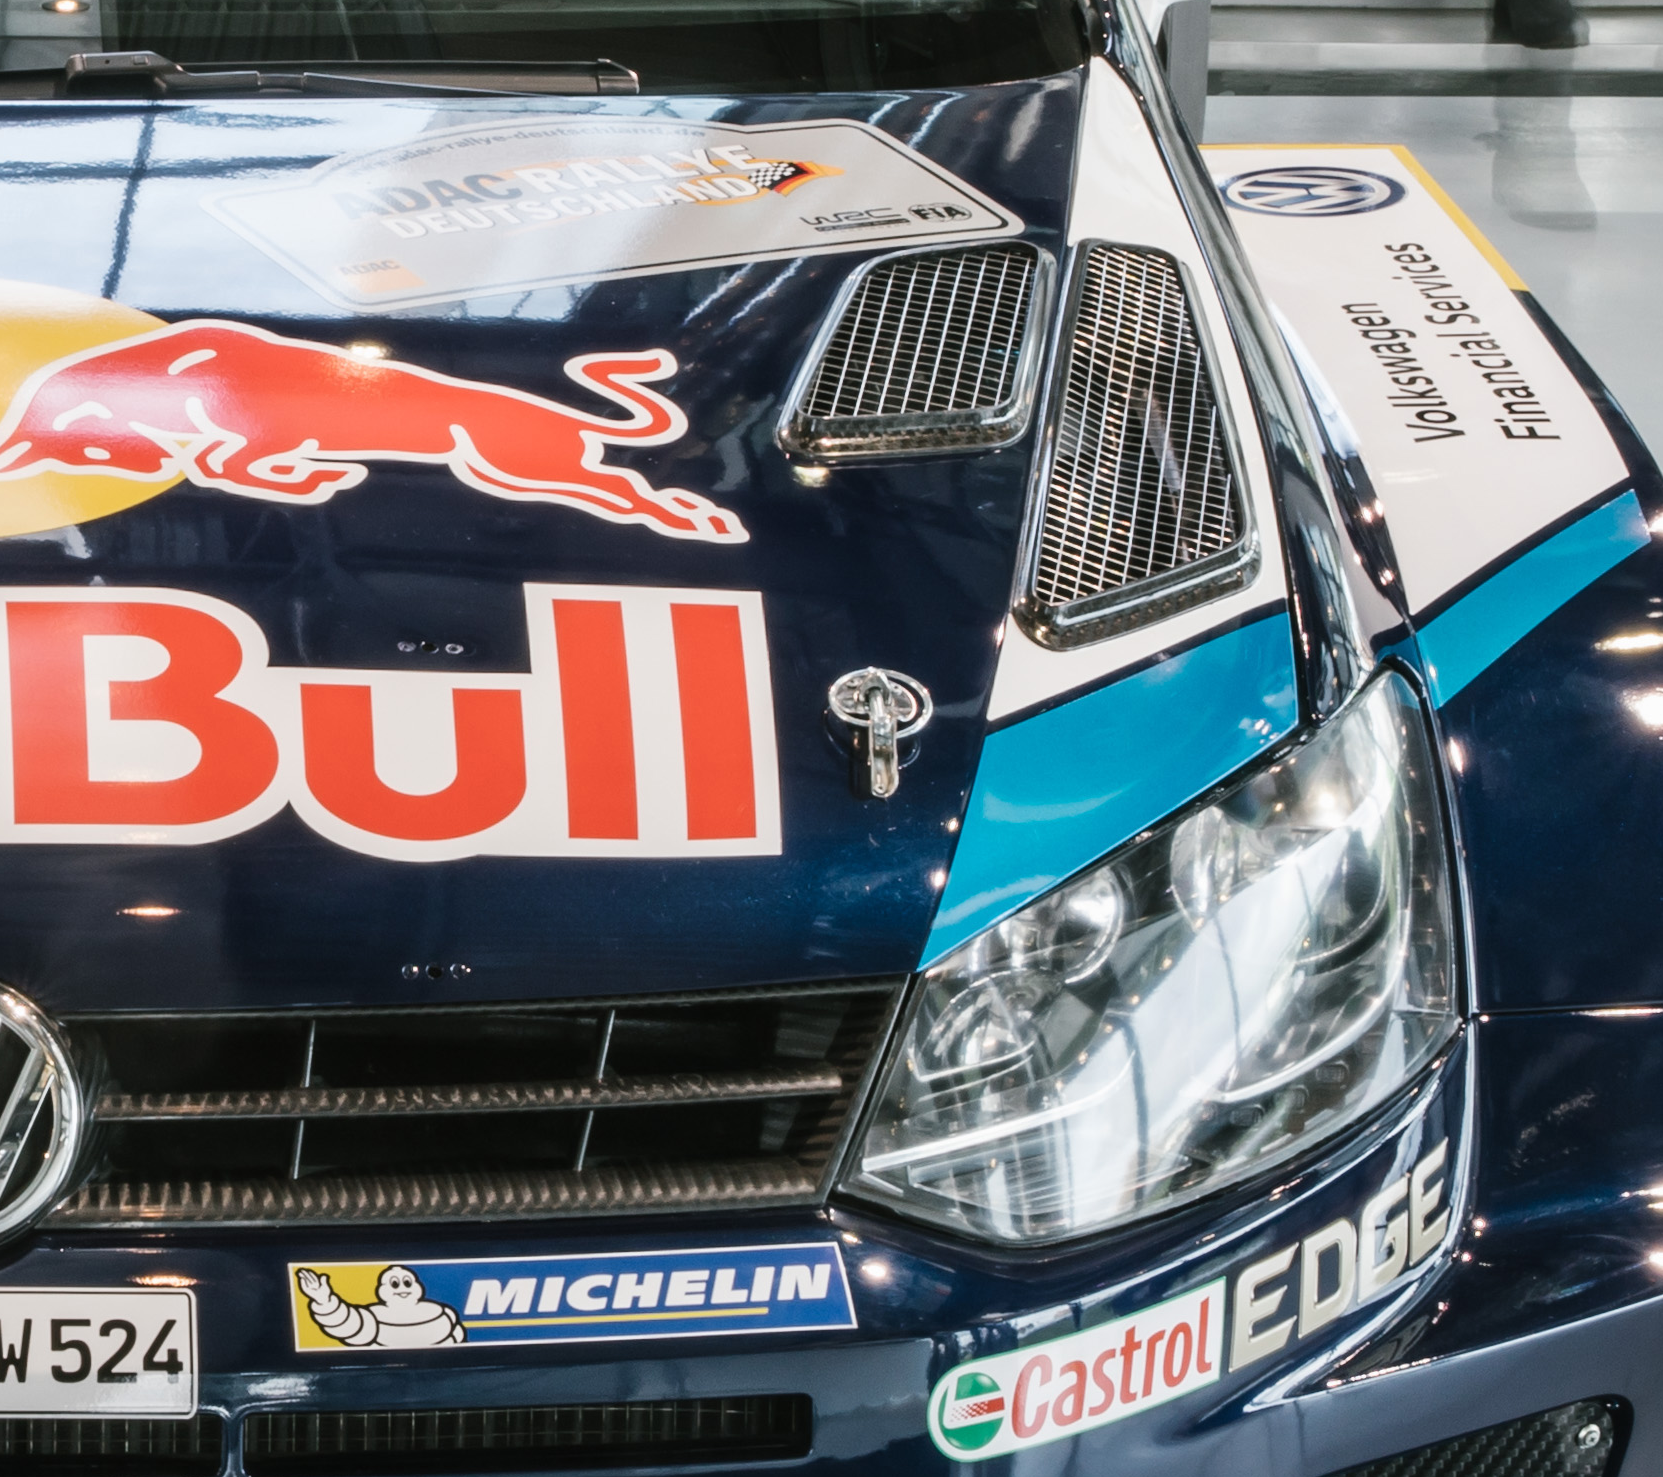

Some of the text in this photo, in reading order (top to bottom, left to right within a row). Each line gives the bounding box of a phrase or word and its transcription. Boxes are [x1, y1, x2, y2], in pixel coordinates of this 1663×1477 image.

[333, 143, 759, 220] ADAC RALLYE
[378, 174, 760, 240] DEUTSCHLAND
[910, 205, 968, 221] FIA
[1341, 302, 1466, 443] Volkswagen
[1384, 242, 1562, 440] Financial Services
[469, 1263, 833, 1316] MICHELIN
[1009, 1138, 1453, 1440] Castrol EDGE
[49, 1316, 185, 1385] 524
